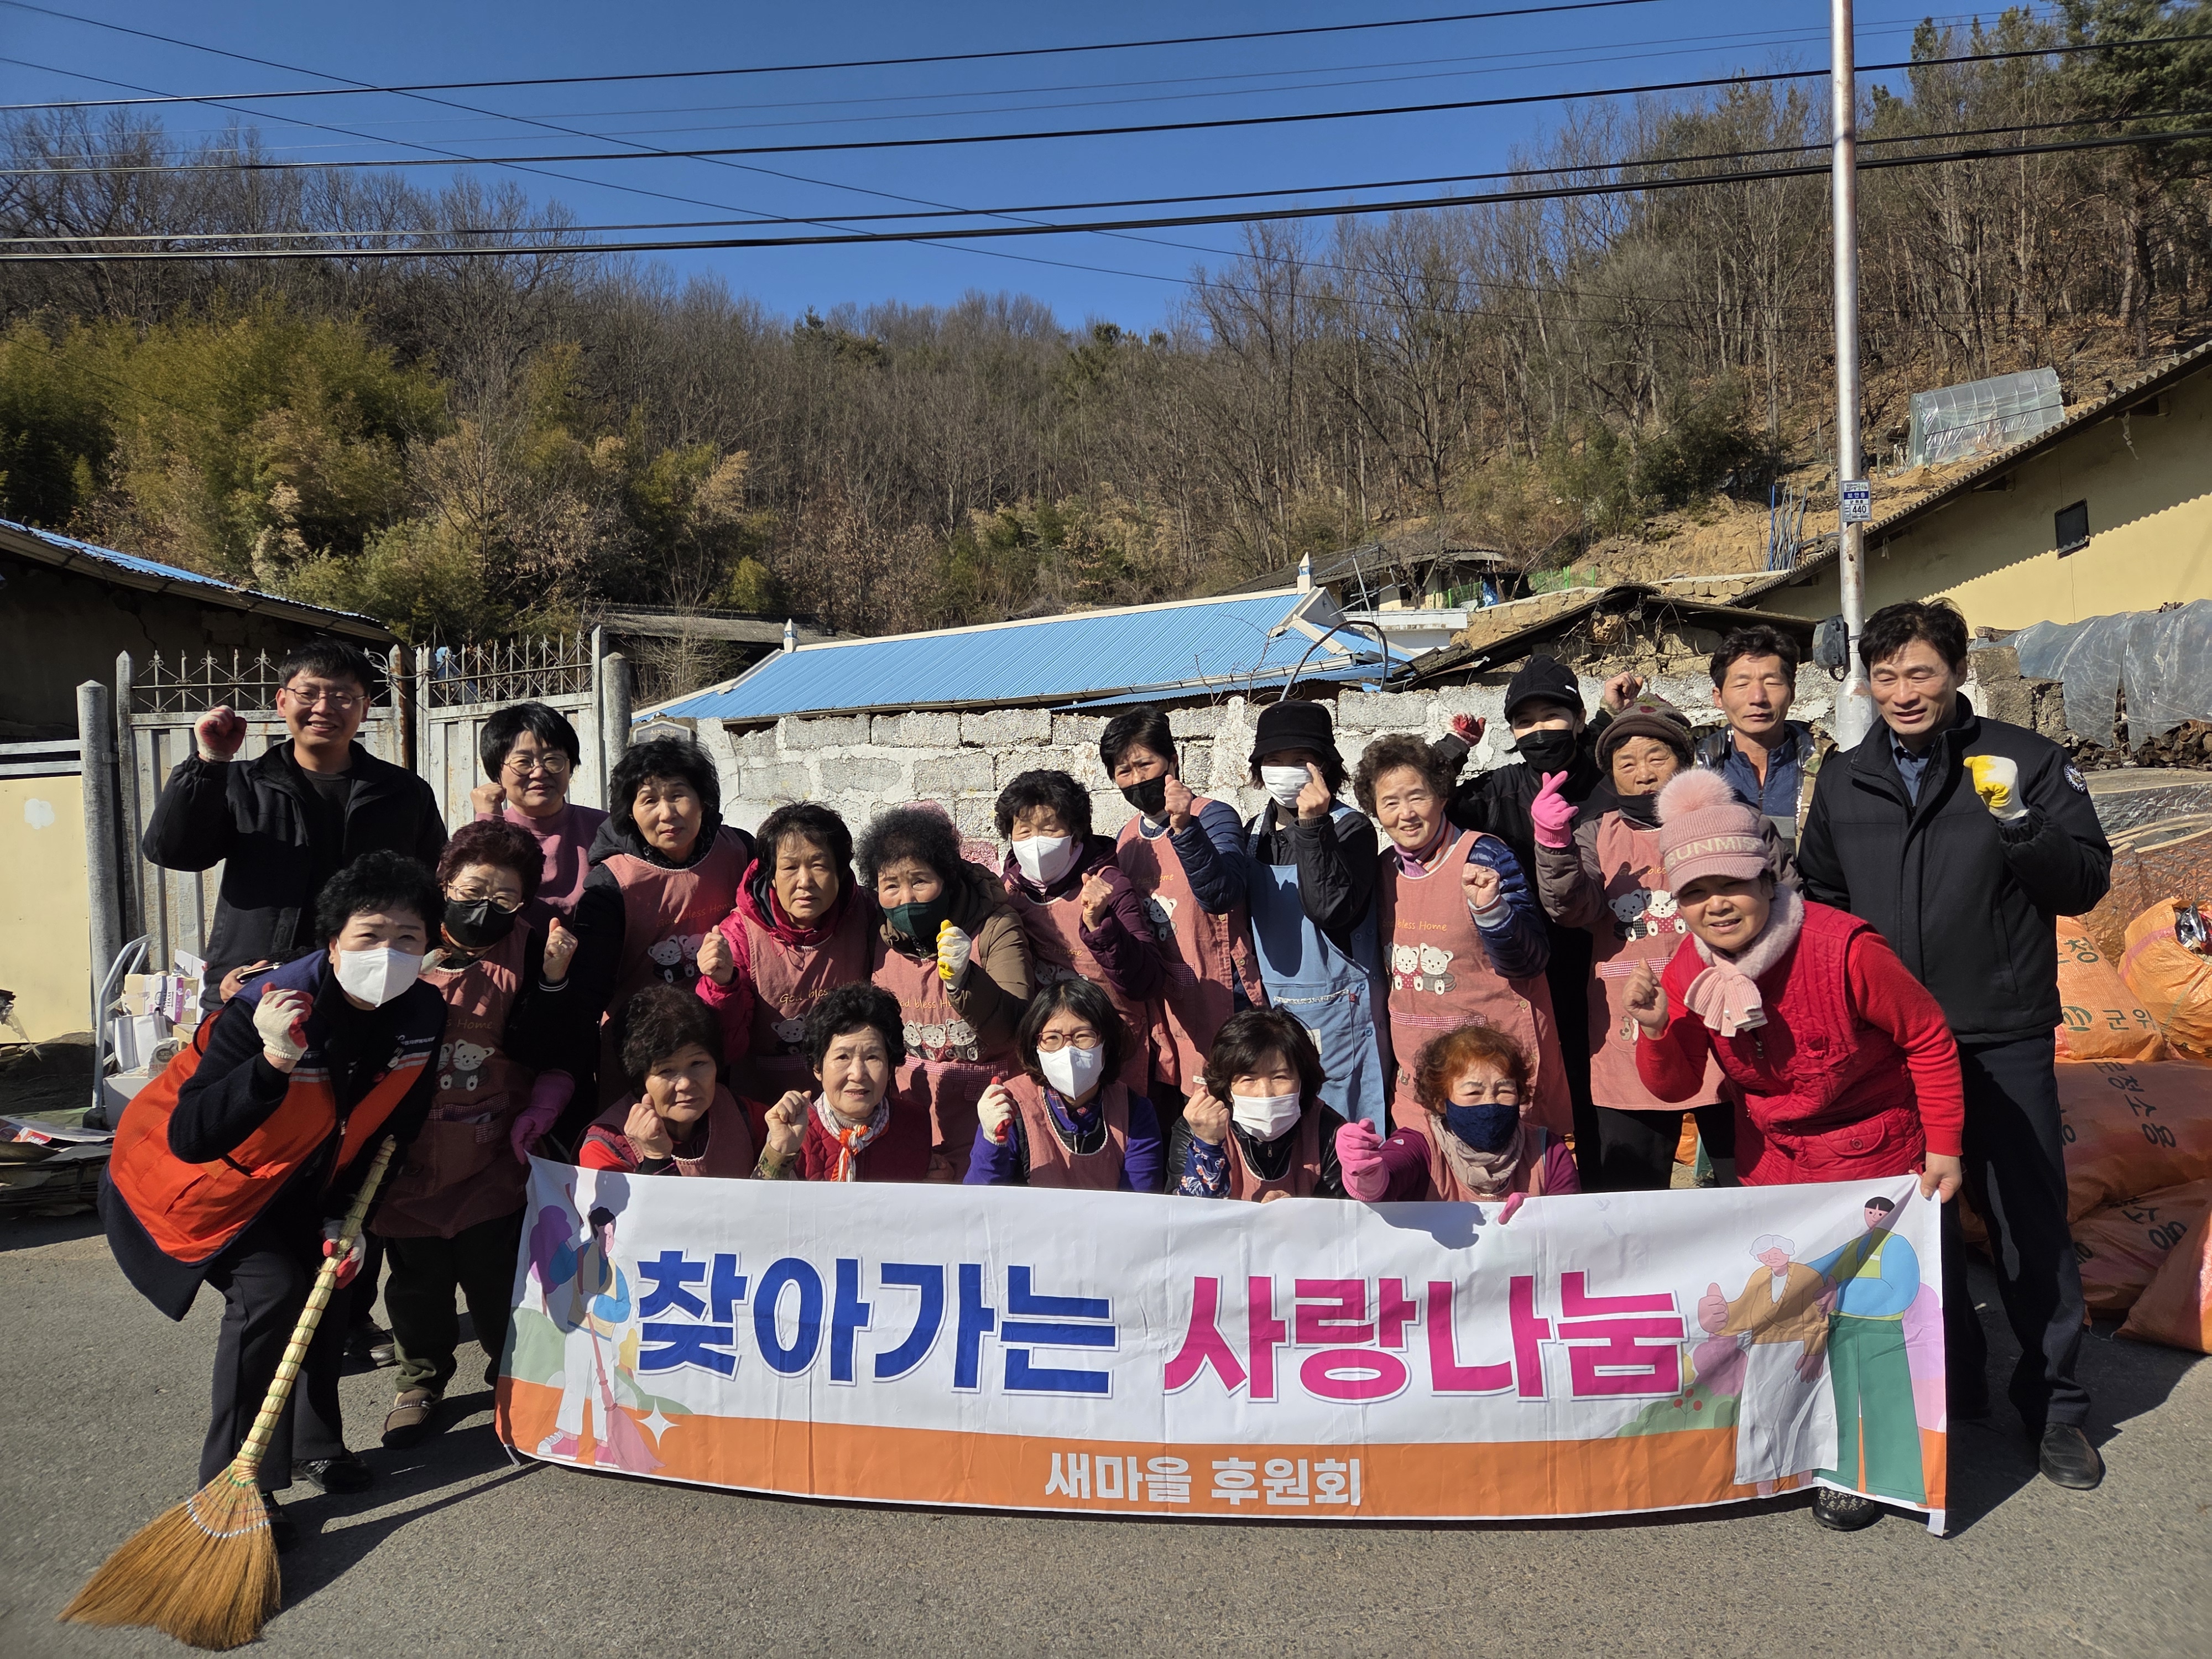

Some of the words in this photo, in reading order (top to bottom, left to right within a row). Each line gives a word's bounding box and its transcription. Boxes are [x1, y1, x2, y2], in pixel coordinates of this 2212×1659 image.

[1852, 505, 1866, 513] 440
[1397, 918, 1416, 930] bless
[1418, 921, 1448, 932] Home
[914, 998, 937, 1009] bless
[457, 1019, 493, 1029] Home
[636, 1250, 1117, 1394] 찾아가는
[1164, 1271, 1684, 1401] 사랑나눔
[1045, 1452, 1192, 1504] 새마을
[1211, 1457, 1361, 1506] 후원회
